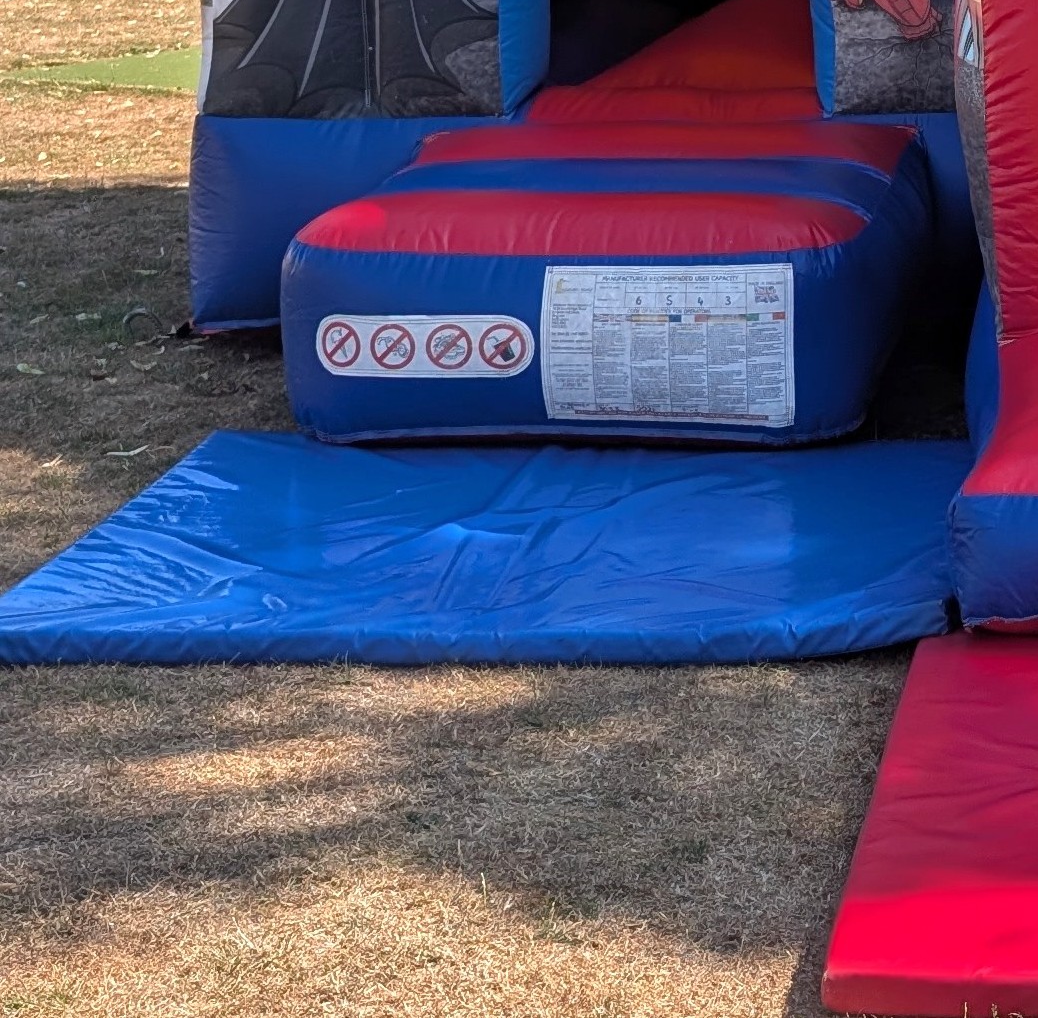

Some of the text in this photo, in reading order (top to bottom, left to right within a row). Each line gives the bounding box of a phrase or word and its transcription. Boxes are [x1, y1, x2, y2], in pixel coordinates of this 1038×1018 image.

[635, 296, 642, 305] 6
[666, 295, 673, 306] 5
[697, 297, 704, 306] 4
[725, 296, 732, 306] 3
